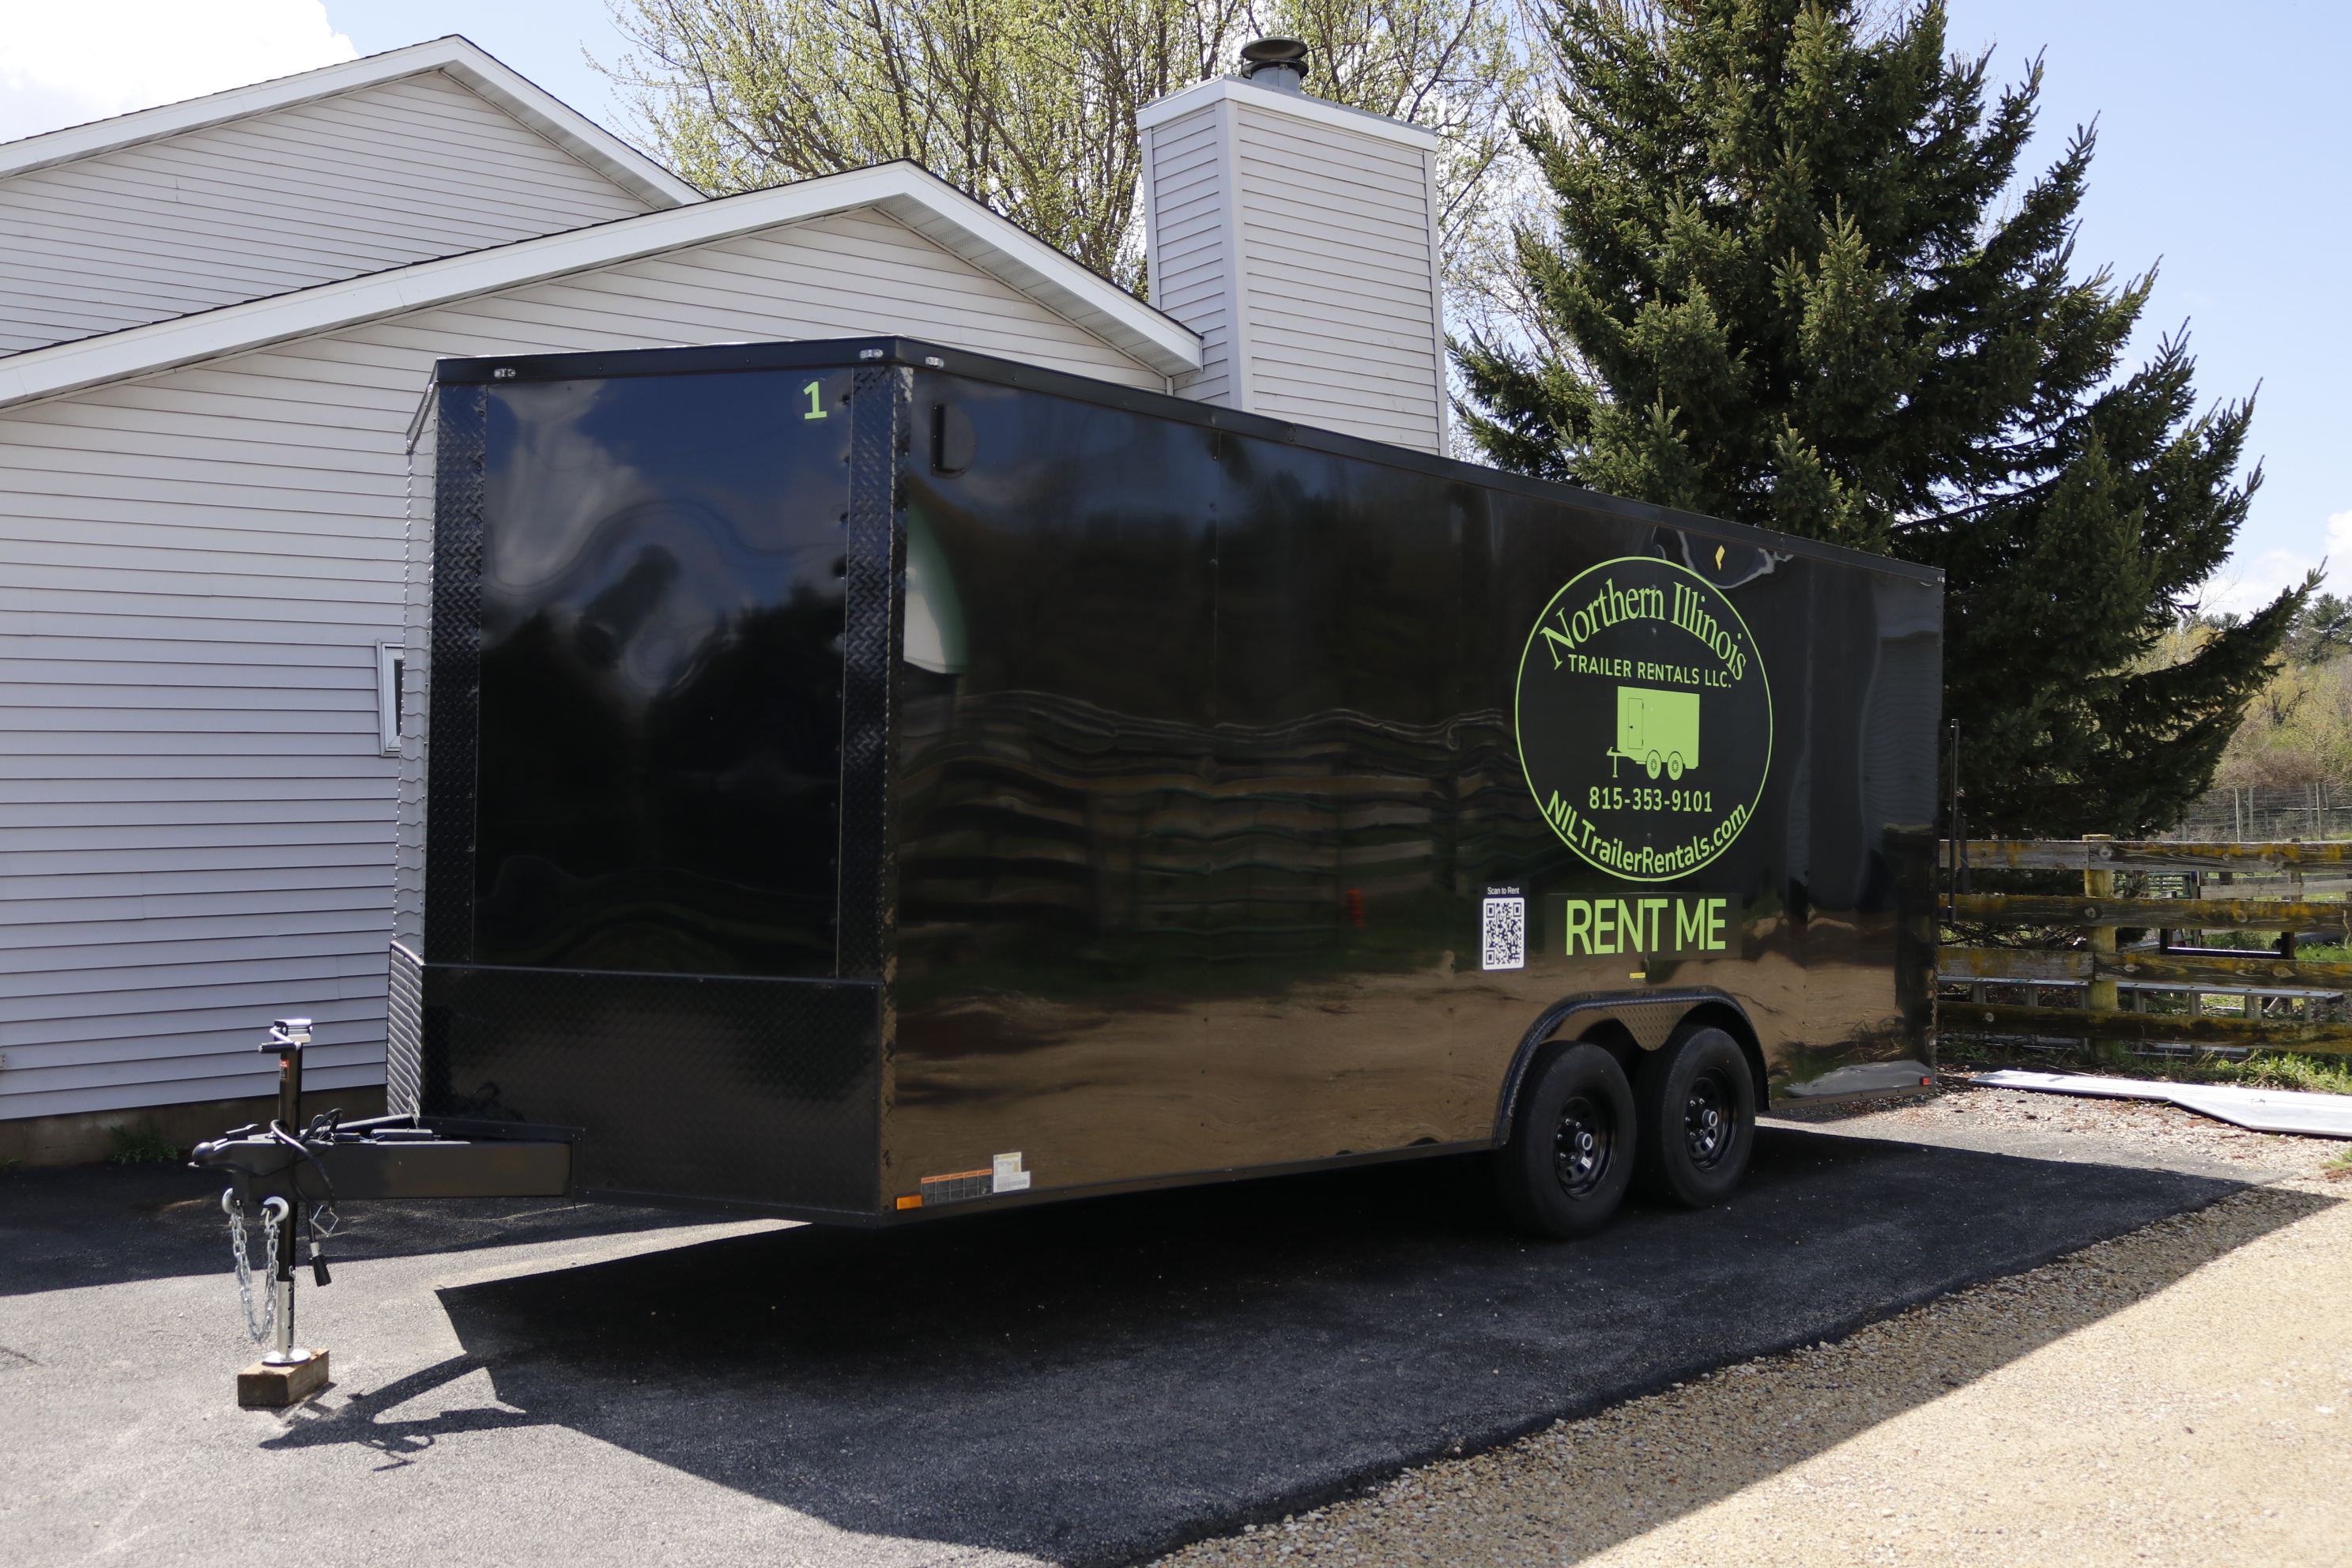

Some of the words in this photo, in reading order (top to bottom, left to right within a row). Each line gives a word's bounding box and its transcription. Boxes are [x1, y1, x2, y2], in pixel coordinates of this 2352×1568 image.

[803, 380, 827, 420] 1
[1539, 578, 1666, 670] Northern
[1670, 581, 1747, 680] Illinois
[1567, 654, 1632, 678] TRAILER
[1637, 661, 1700, 685] RENTALS
[1705, 669, 1732, 688] LLC.
[1589, 786, 1713, 812] 815-353-9101
[1546, 789, 1747, 874] NILTrailerRentals.com
[1487, 886, 1501, 895] Scan
[1507, 886, 1520, 895] Rent
[1566, 898, 1668, 956] RENT
[1675, 898, 1728, 952] ME
